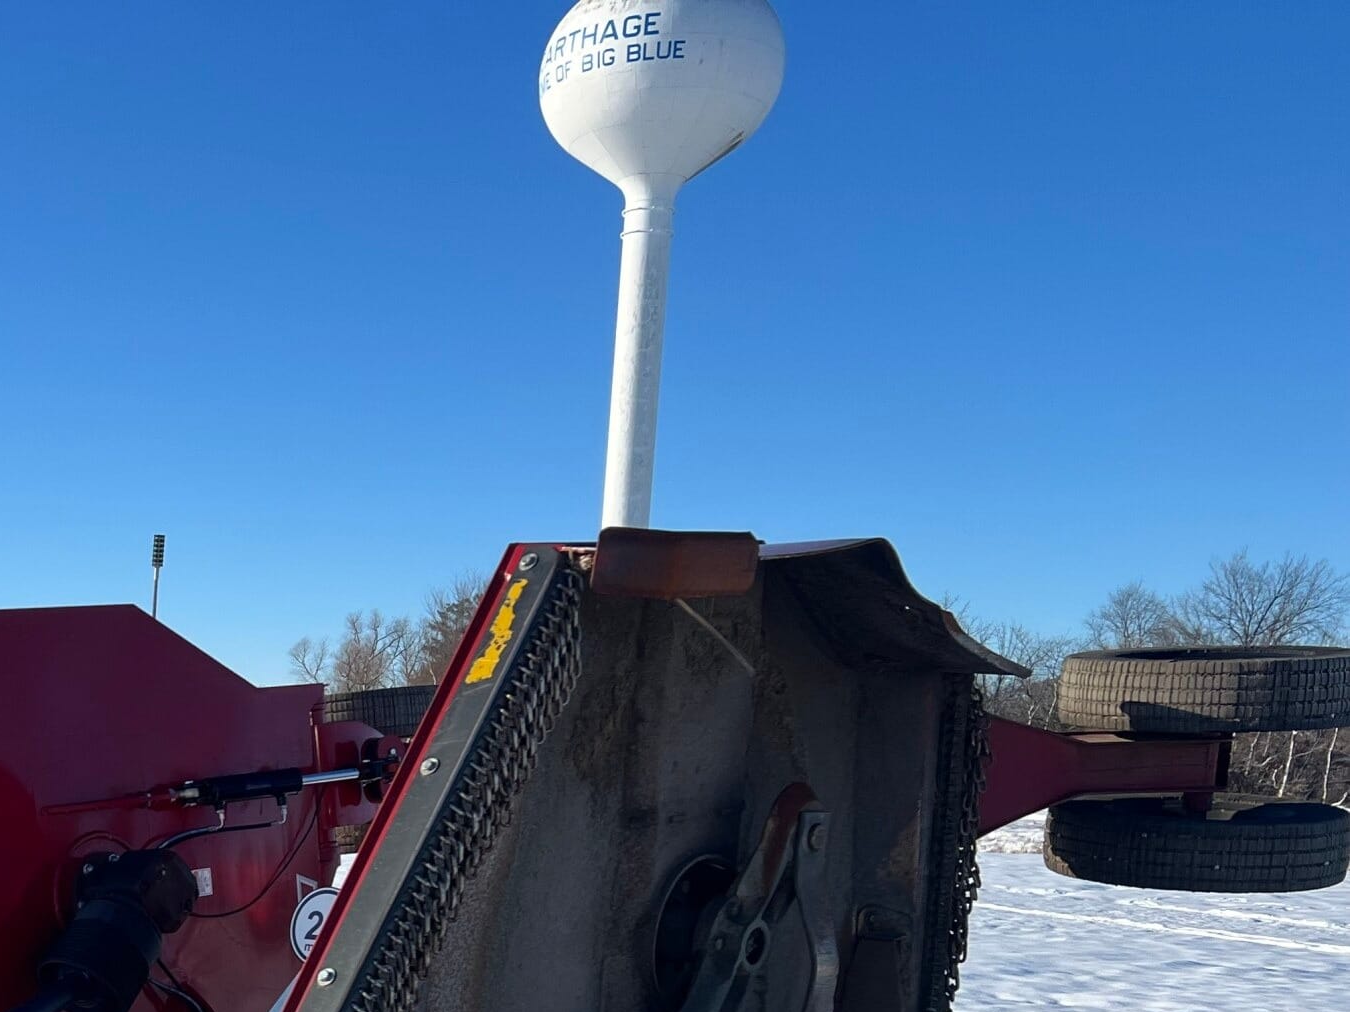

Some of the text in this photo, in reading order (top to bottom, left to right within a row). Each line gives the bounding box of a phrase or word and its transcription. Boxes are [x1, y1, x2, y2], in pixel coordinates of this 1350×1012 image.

[556, 60, 572, 83] OF
[581, 48, 616, 73] BIG
[626, 40, 686, 63] BLUE
